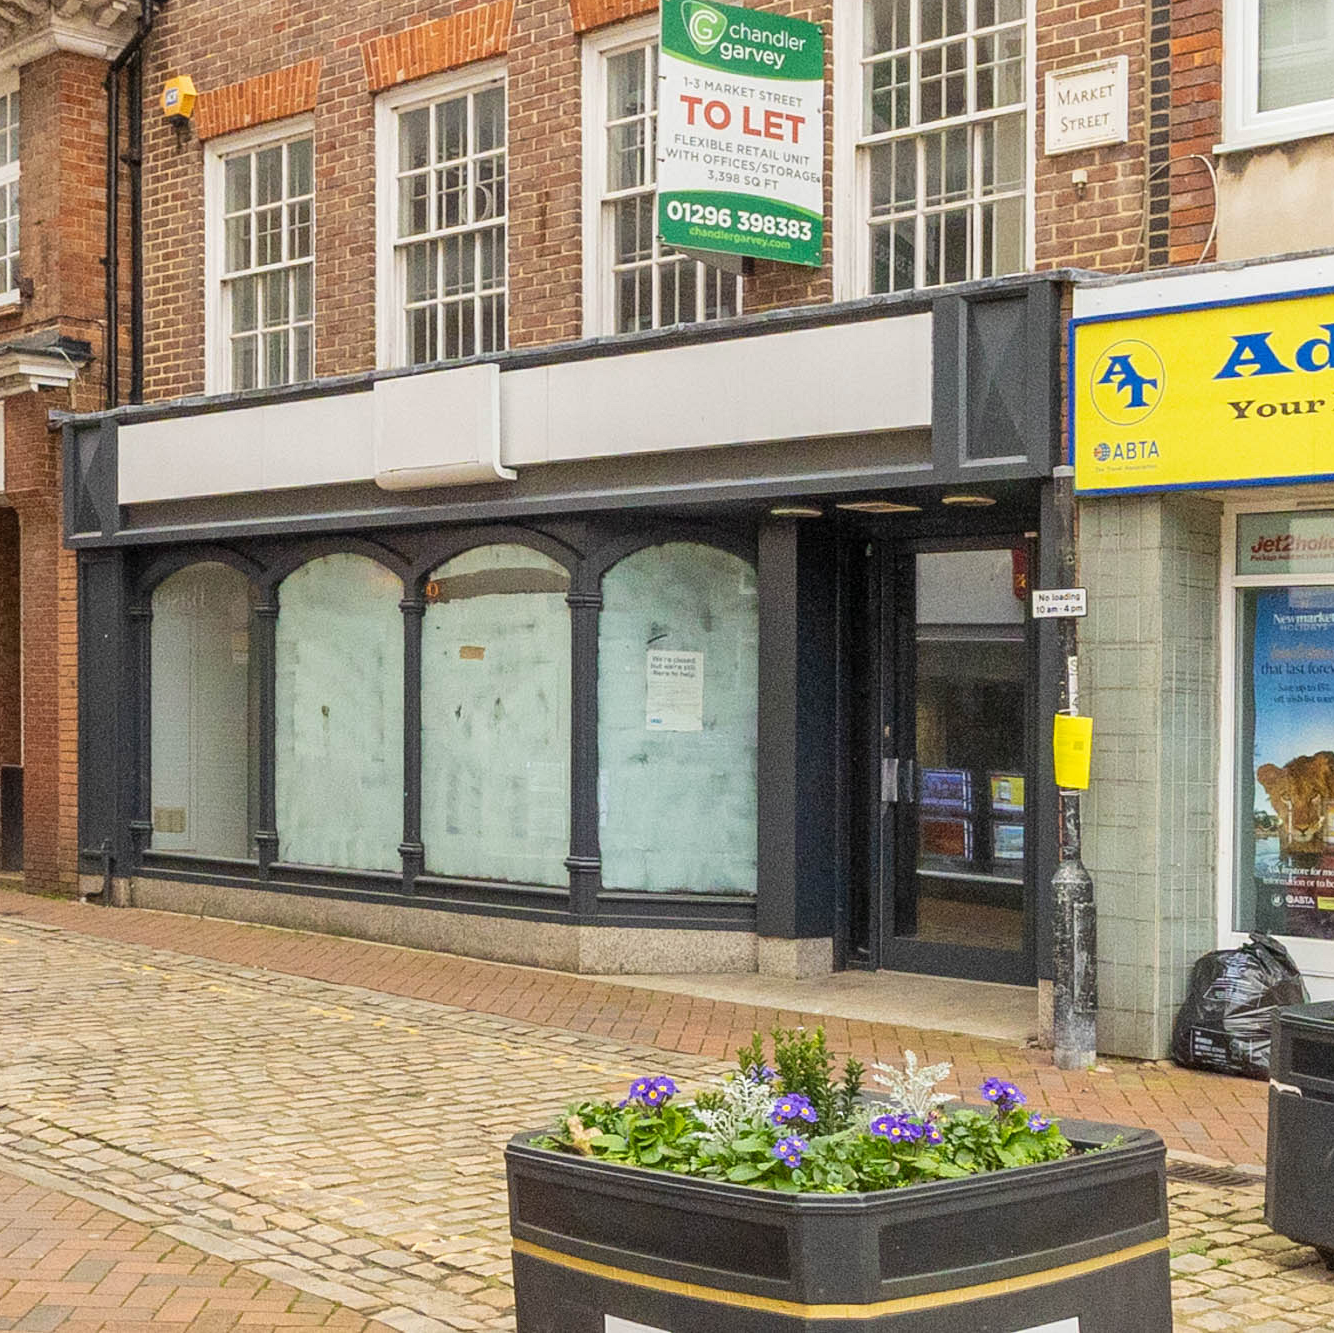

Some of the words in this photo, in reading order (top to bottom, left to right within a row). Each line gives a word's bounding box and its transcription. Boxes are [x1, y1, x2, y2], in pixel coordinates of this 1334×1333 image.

[729, 22, 807, 52] chandler
[719, 41, 786, 70] garvey
[682, 77, 701, 90] 1-3
[704, 80, 756, 99] MARKET
[759, 90, 803, 108] STREET
[679, 94, 732, 131] TO
[742, 106, 806, 144] LET
[674, 133, 733, 153] FLEXIBLE
[737, 143, 779, 161] RETAIL
[782, 152, 811, 166] UNIT
[666, 147, 700, 163] WITH
[703, 153, 818, 183] OFFICES/STORAGE
[707, 169, 740, 184] 3,398
[744, 176, 761, 187] SQ
[764, 179, 779, 191] FT
[667, 200, 732, 229] 01296
[736, 210, 813, 242] 398383
[688, 225, 792, 250] chandlergarvey.com
[1227, 396, 1326, 420] Your
[1112, 440, 1160, 462] ABTA
[1036, 605, 1046, 614] 10
[1064, 604, 1069, 613] 4
[1071, 606, 1084, 616] pm
[1038, 593, 1050, 602] No
[1052, 592, 1081, 603] loading
[1261, 662, 1282, 675] that
[1286, 662, 1305, 675] last
